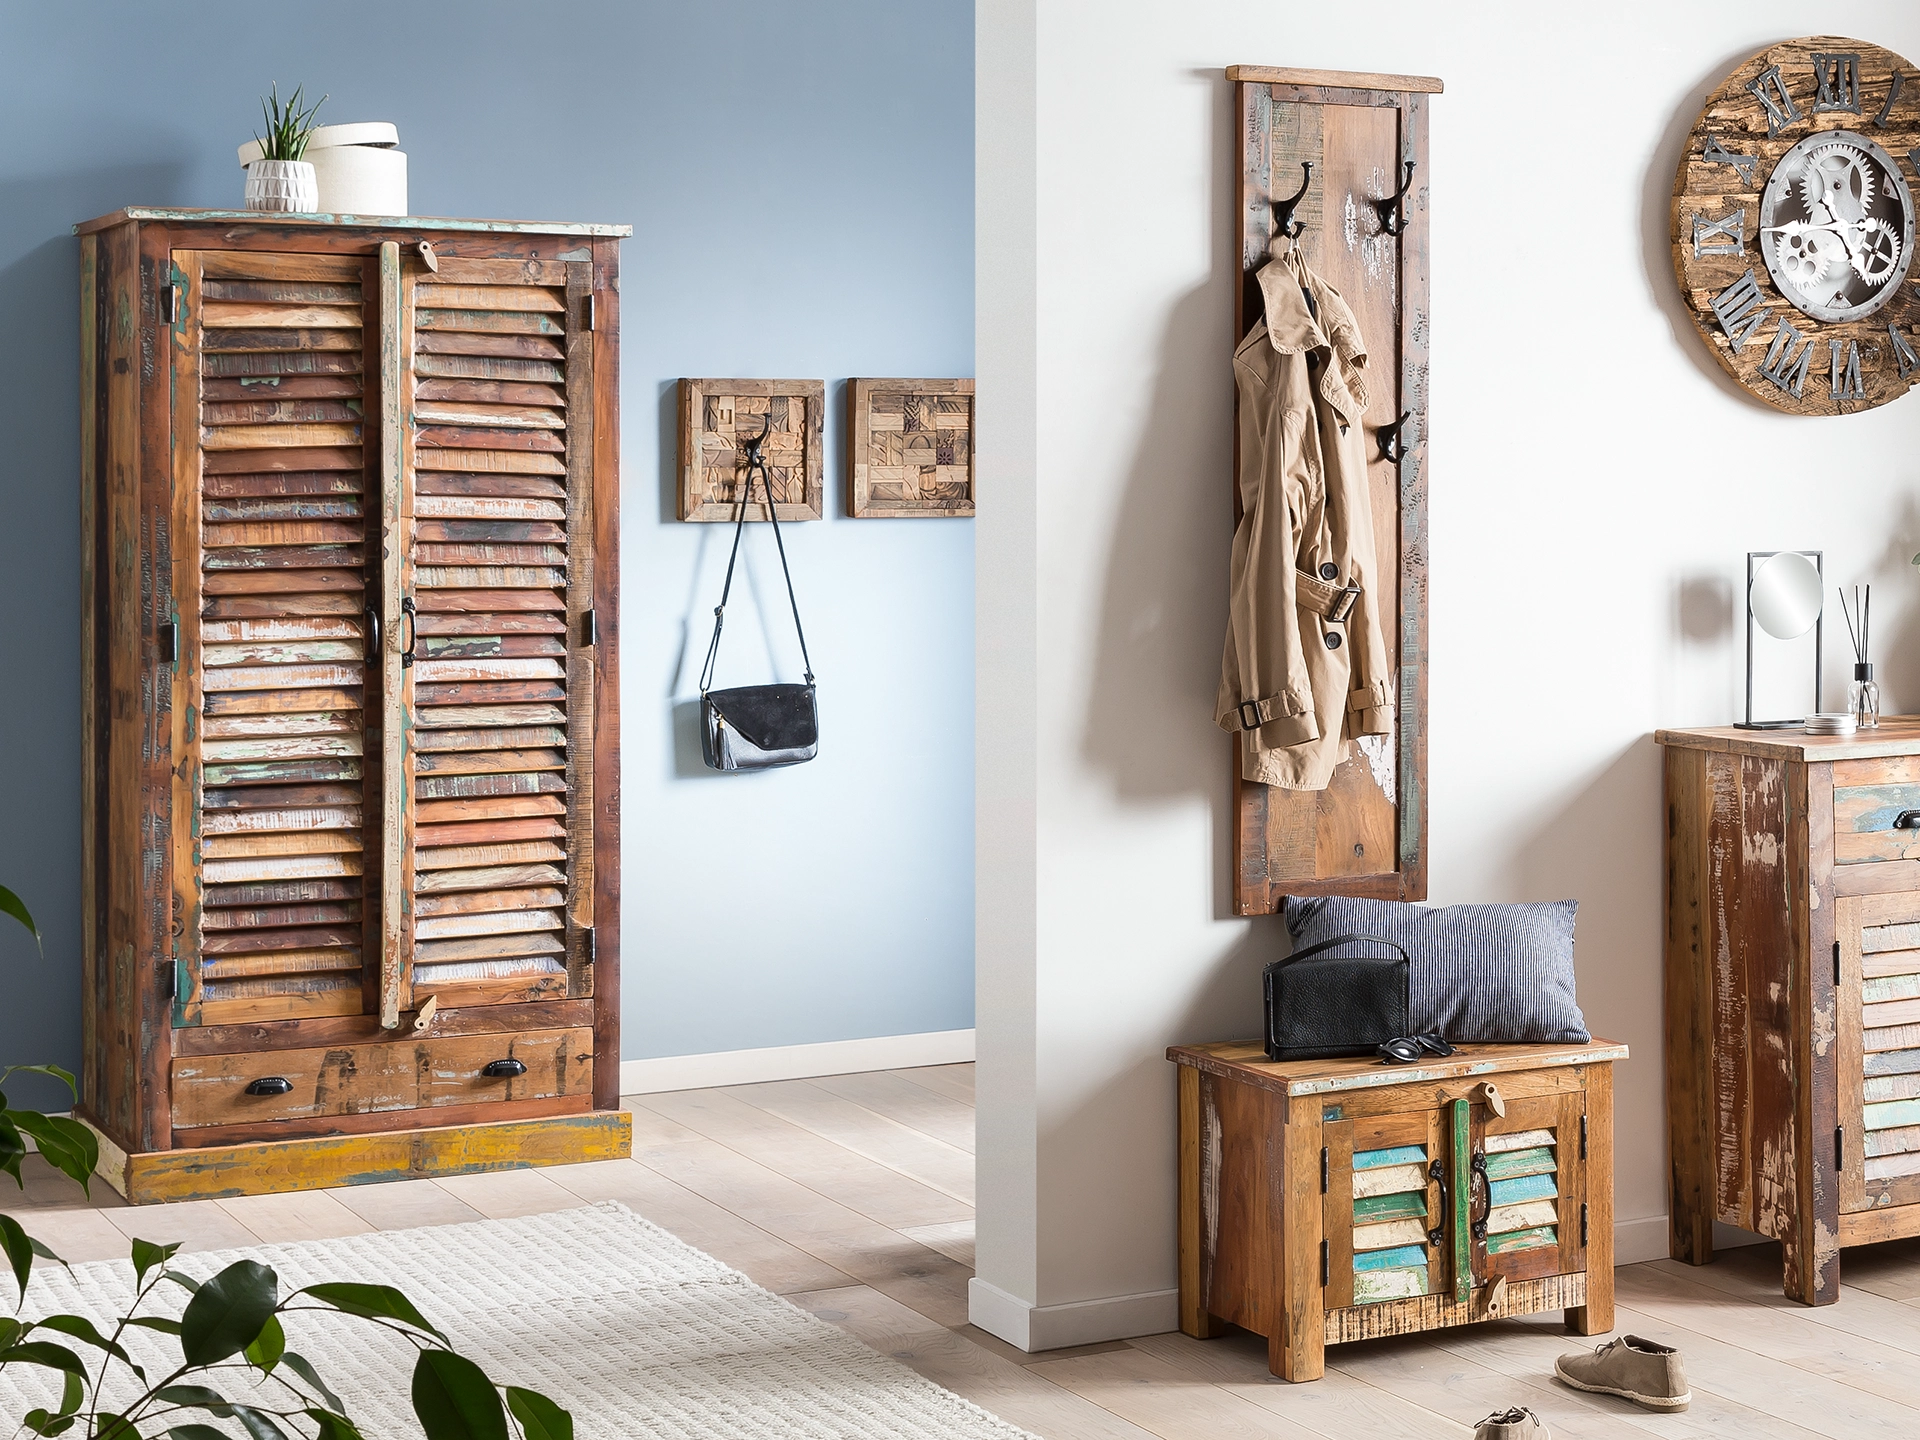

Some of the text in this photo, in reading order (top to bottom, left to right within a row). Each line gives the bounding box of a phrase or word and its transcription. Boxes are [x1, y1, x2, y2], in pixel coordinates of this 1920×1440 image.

[1745, 64, 1802, 139] XI
[1810, 52, 1862, 116] XII
[1873, 70, 1906, 128] I
[1702, 134, 1760, 185] X
[1692, 208, 1745, 260] IX
[1708, 268, 1773, 354] VIII
[1756, 316, 1815, 400] VII
[1828, 338, 1866, 400] VI
